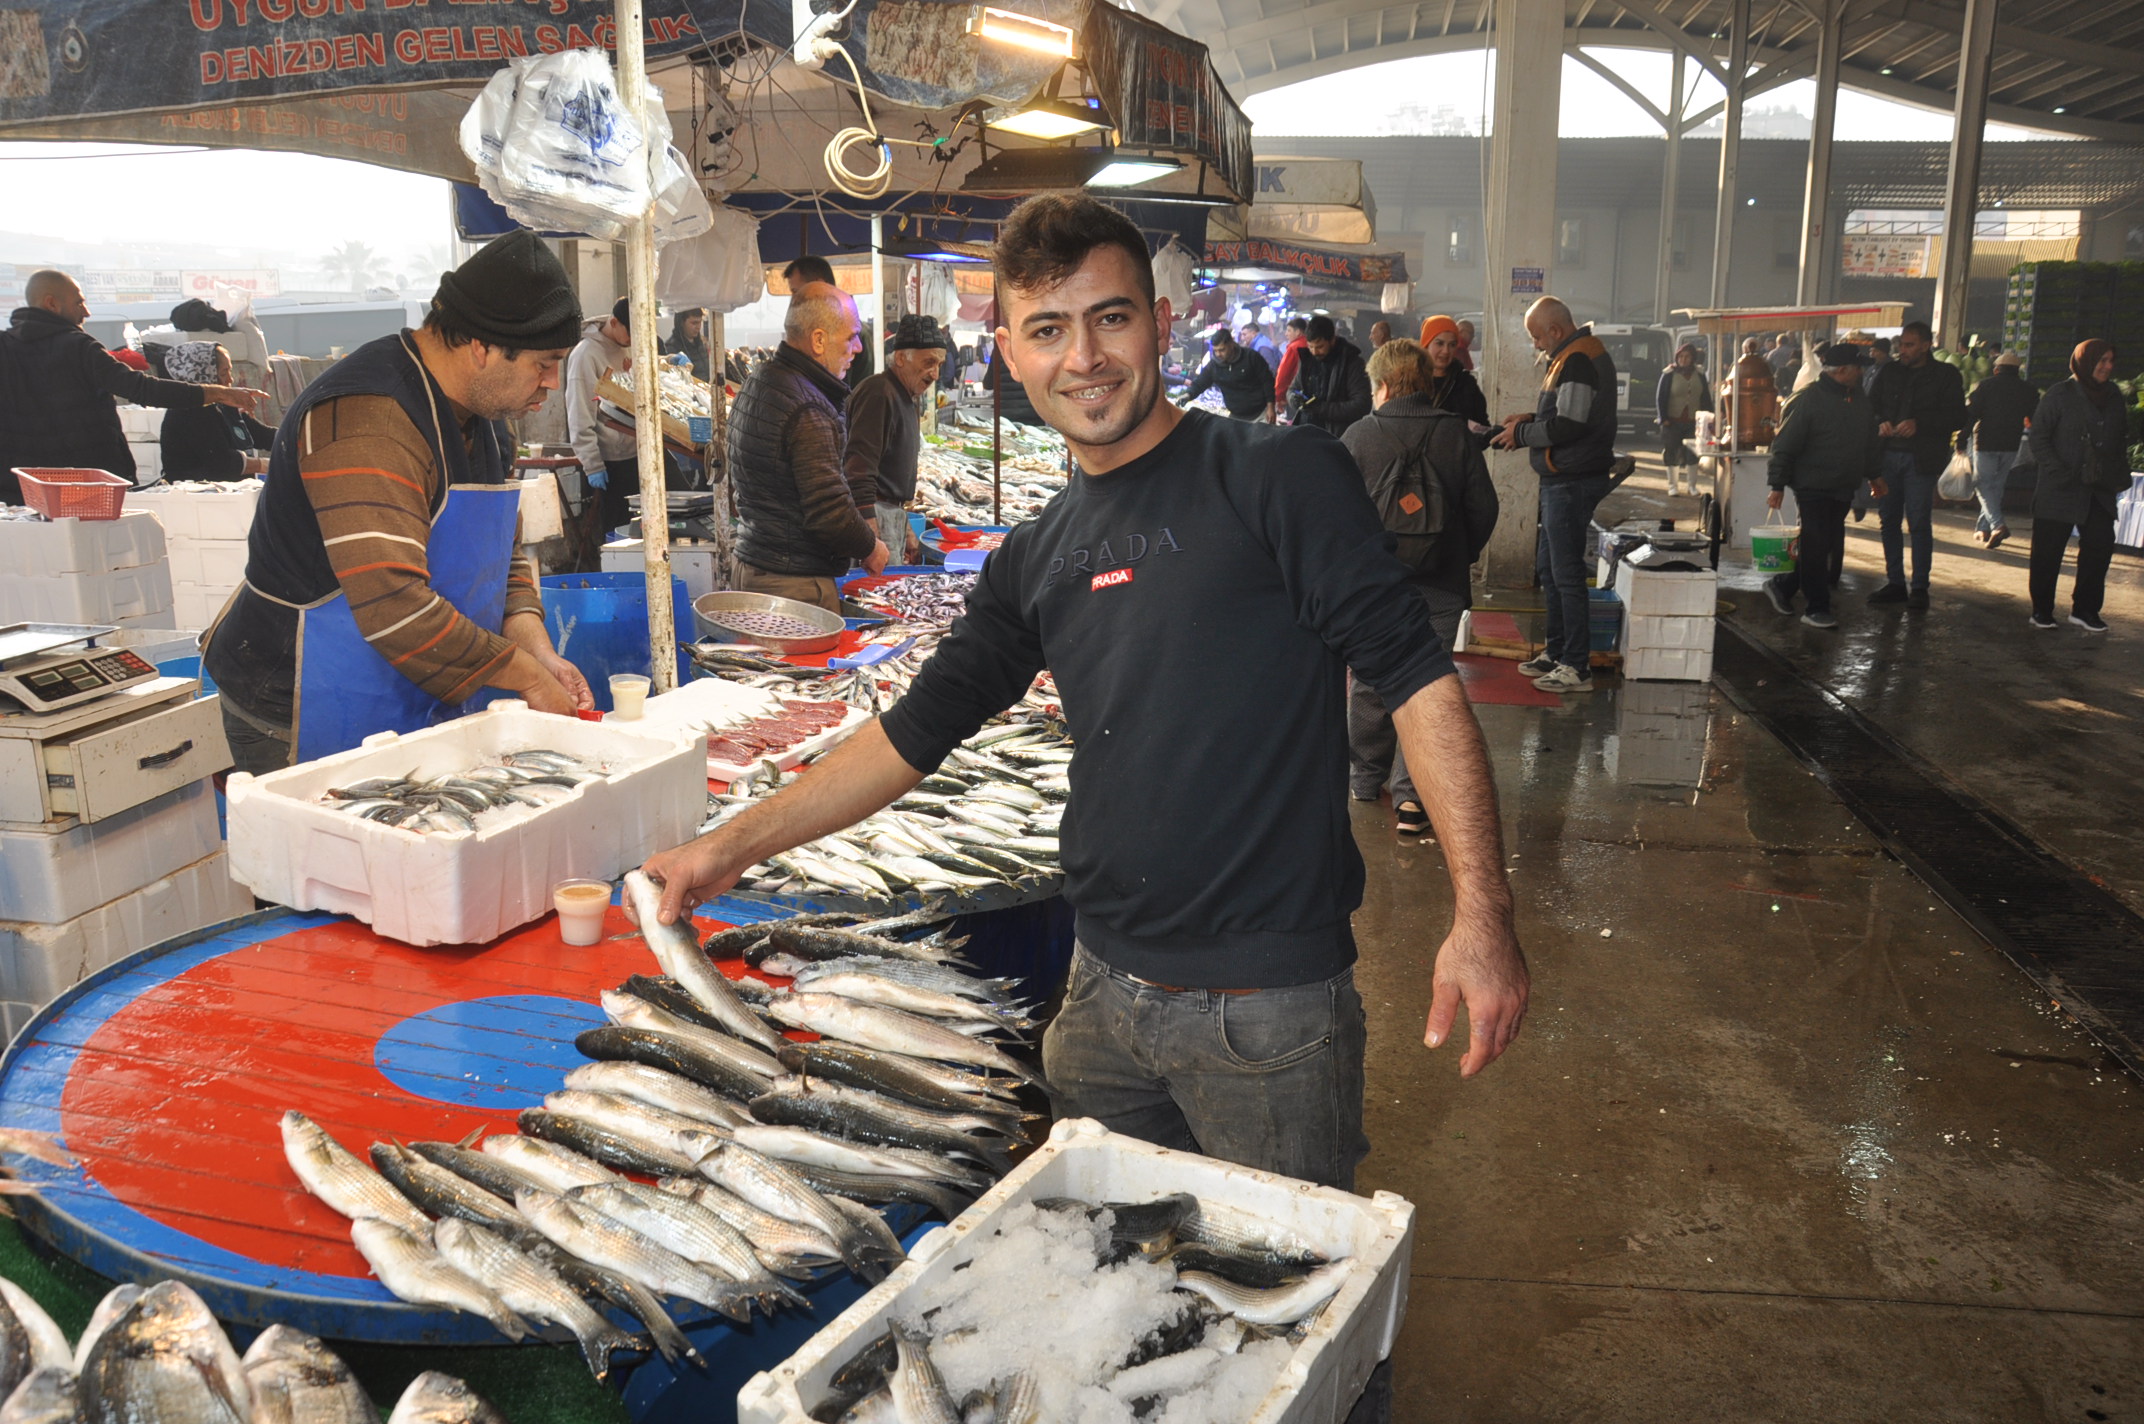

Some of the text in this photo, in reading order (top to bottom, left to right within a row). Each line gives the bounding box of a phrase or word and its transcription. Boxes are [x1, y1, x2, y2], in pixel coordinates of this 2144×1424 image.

[189, 0, 366, 31] UYG
[199, 13, 699, 85] DENİZDEN GELEN SAĞIK
[1246, 242, 1351, 277] BALIKÇILIK
[1047, 527, 1185, 587] PRADA
[1092, 570, 1129, 588] PRADA
